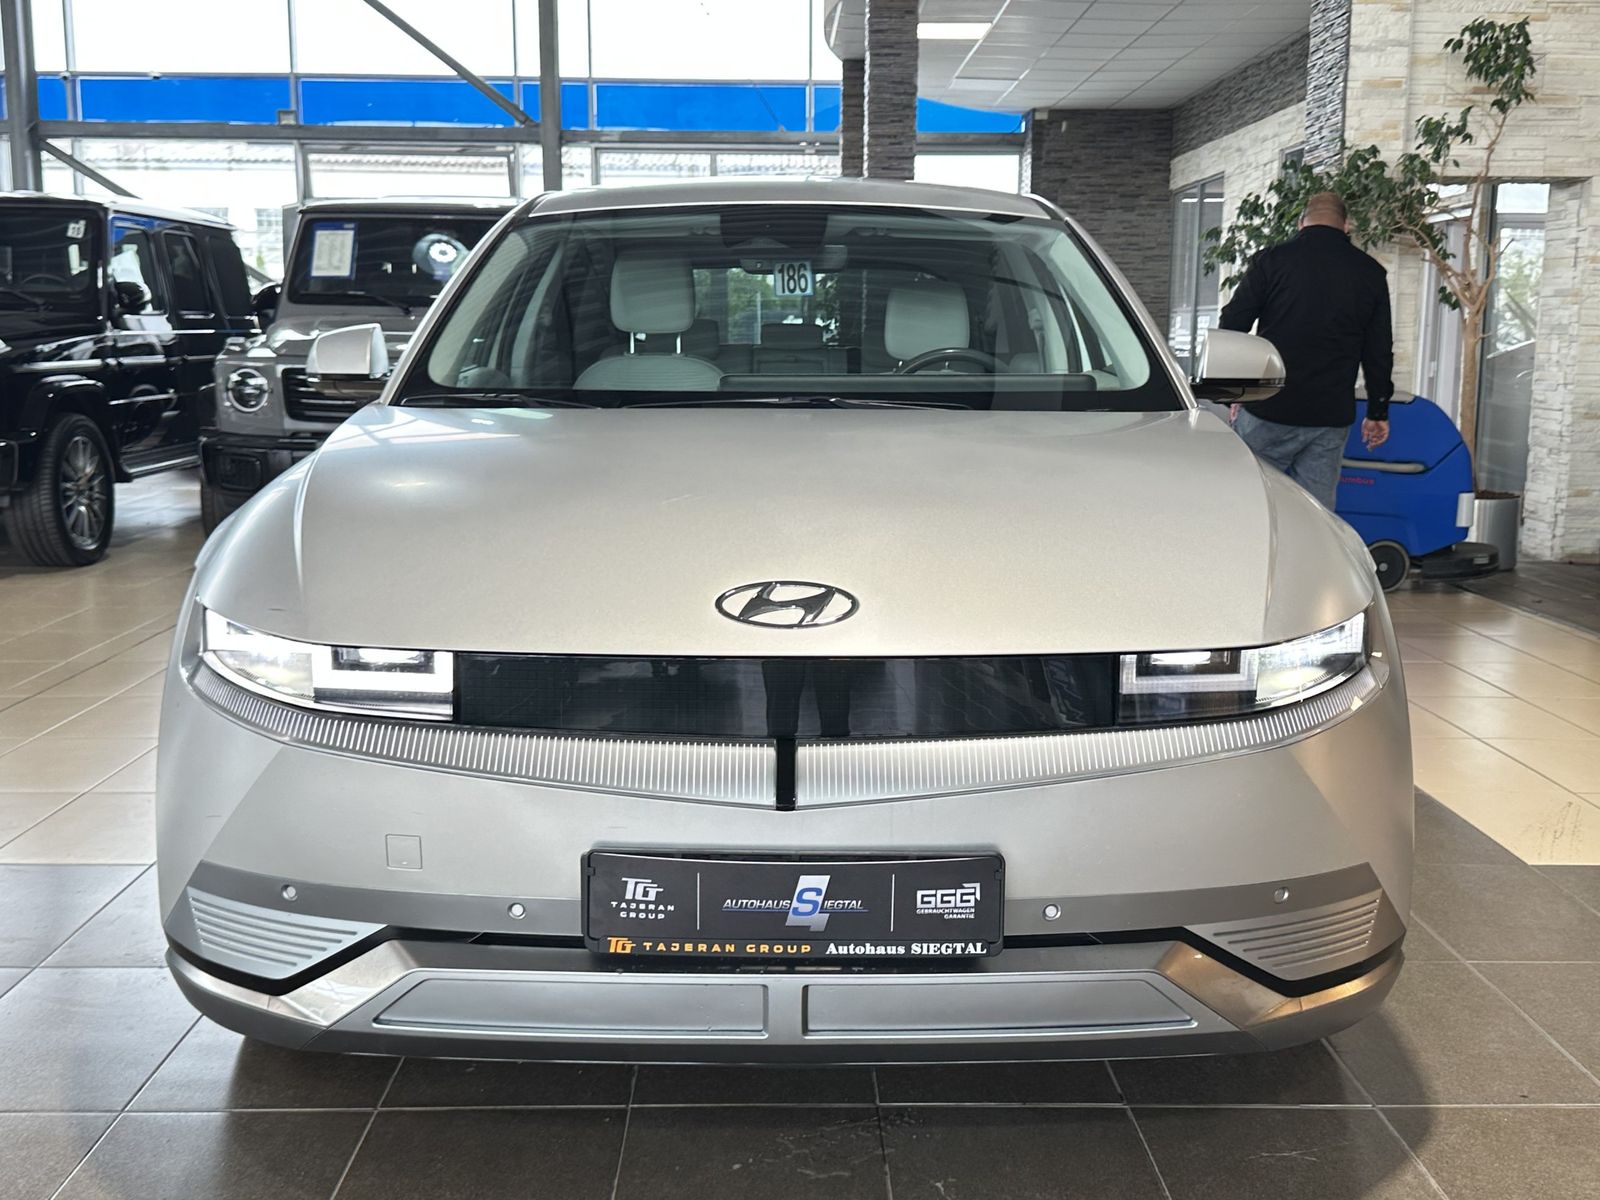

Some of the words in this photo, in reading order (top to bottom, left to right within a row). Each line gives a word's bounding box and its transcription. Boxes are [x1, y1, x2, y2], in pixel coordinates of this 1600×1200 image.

[778, 263, 808, 294] 186
[621, 877, 664, 901] TG
[722, 899, 791, 909] AUTOHAUS
[916, 888, 975, 909] GGG
[610, 901, 675, 911] TAJERAN
[619, 911, 665, 919] GROUP
[642, 942, 735, 953] TAJERAN
[746, 944, 812, 954] GROUP
[825, 942, 906, 955] Autohaus
[910, 942, 987, 955] SIEGTAL
